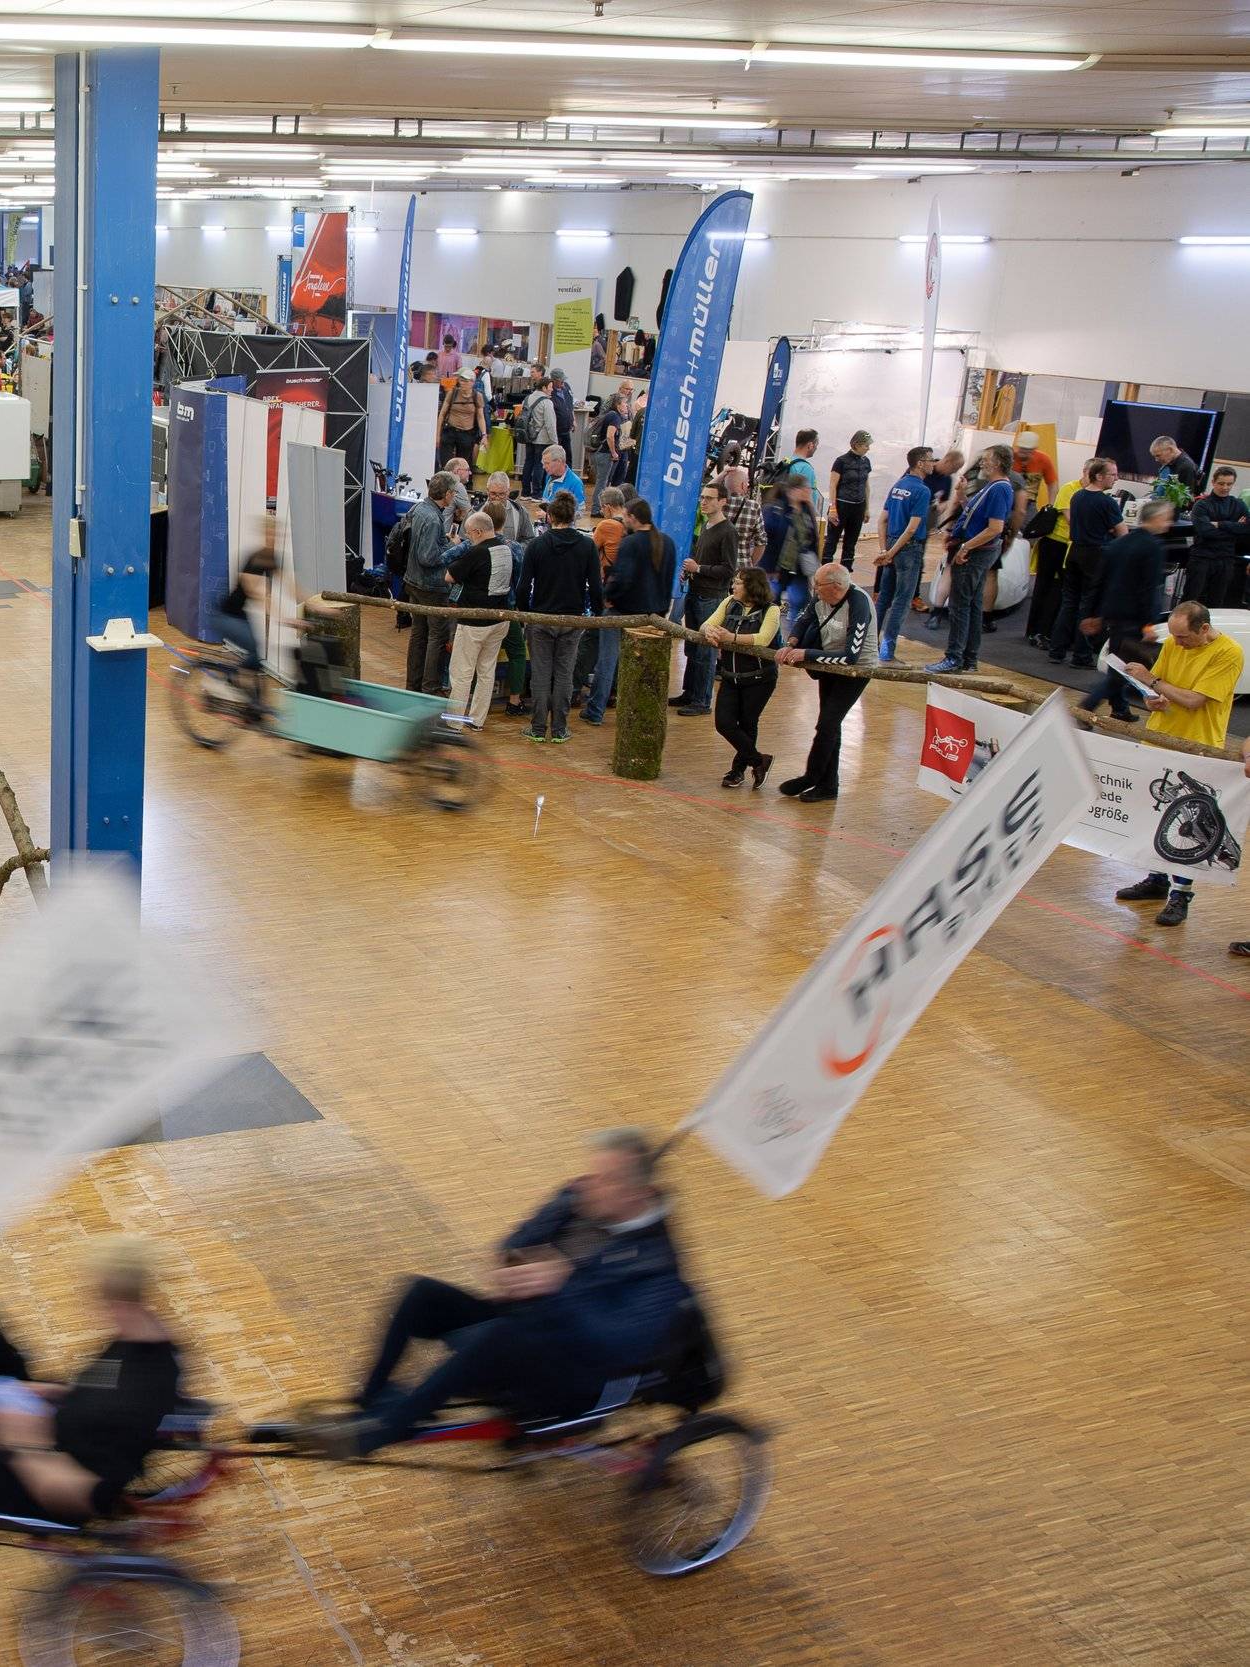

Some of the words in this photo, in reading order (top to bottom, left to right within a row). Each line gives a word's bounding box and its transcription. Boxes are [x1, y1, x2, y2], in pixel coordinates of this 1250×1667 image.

[663, 238, 722, 488] busch+müller
[1093, 773, 1133, 791] echnik
[1098, 791, 1122, 804] ede
